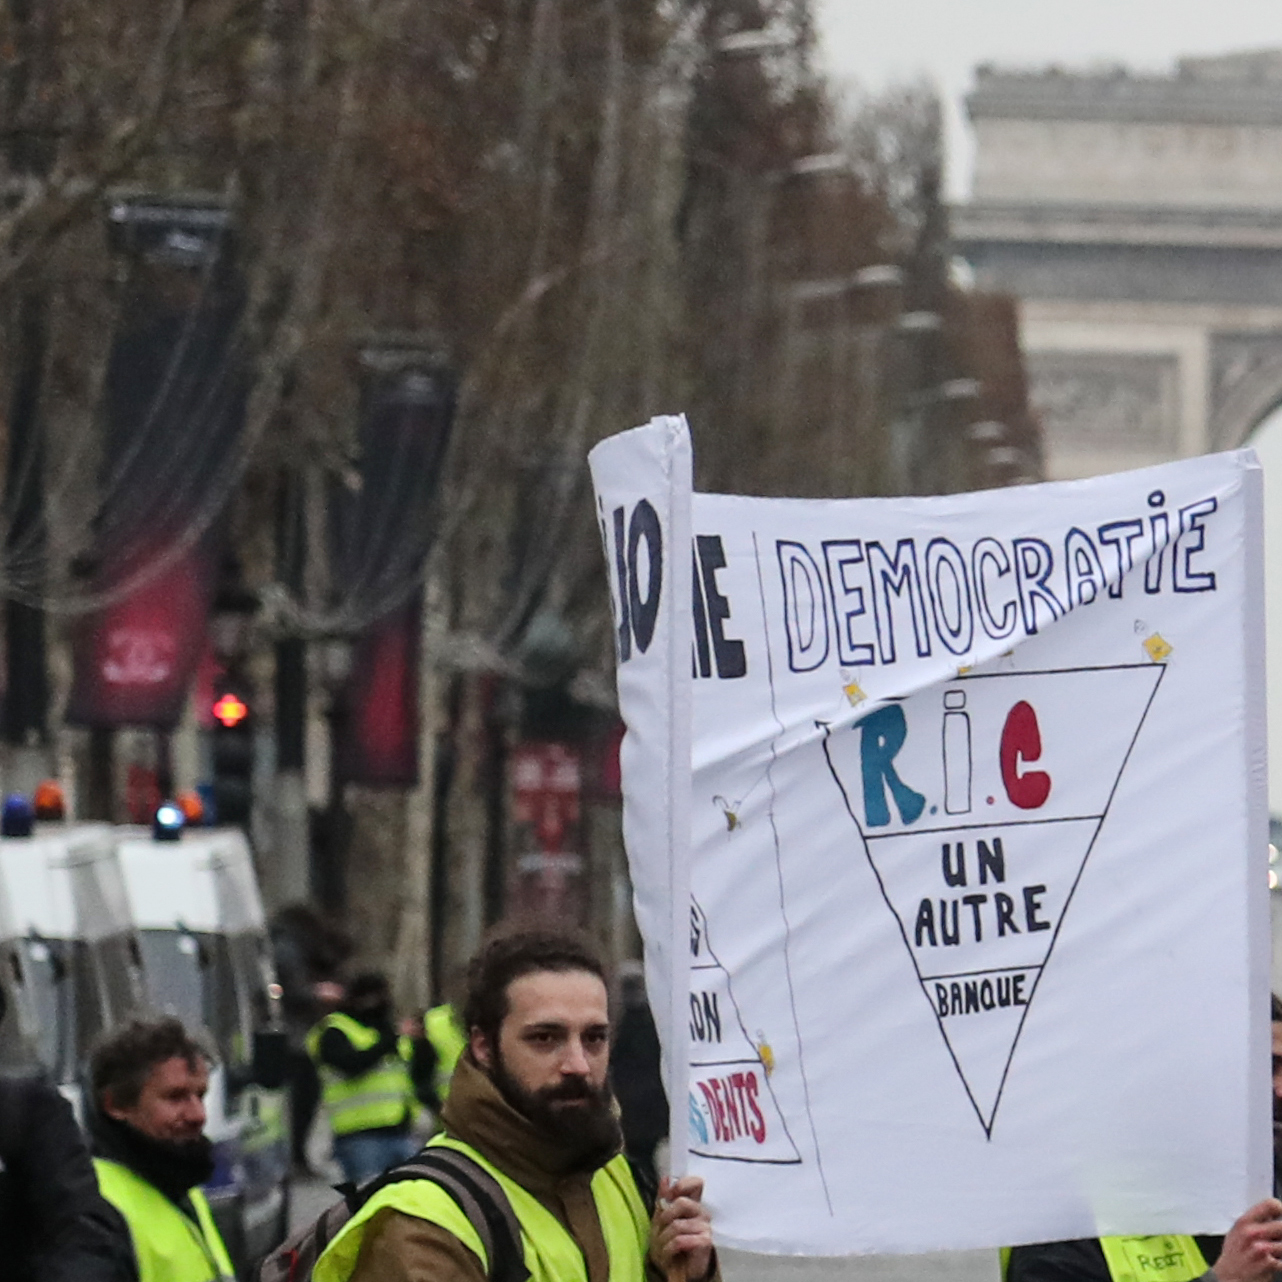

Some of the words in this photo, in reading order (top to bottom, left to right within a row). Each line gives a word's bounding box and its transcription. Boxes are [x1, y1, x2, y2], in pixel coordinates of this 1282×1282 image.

[941, 838, 1005, 887] UN
[914, 885, 1052, 946] AUTRE
[935, 974, 1028, 1017] BANQUE
